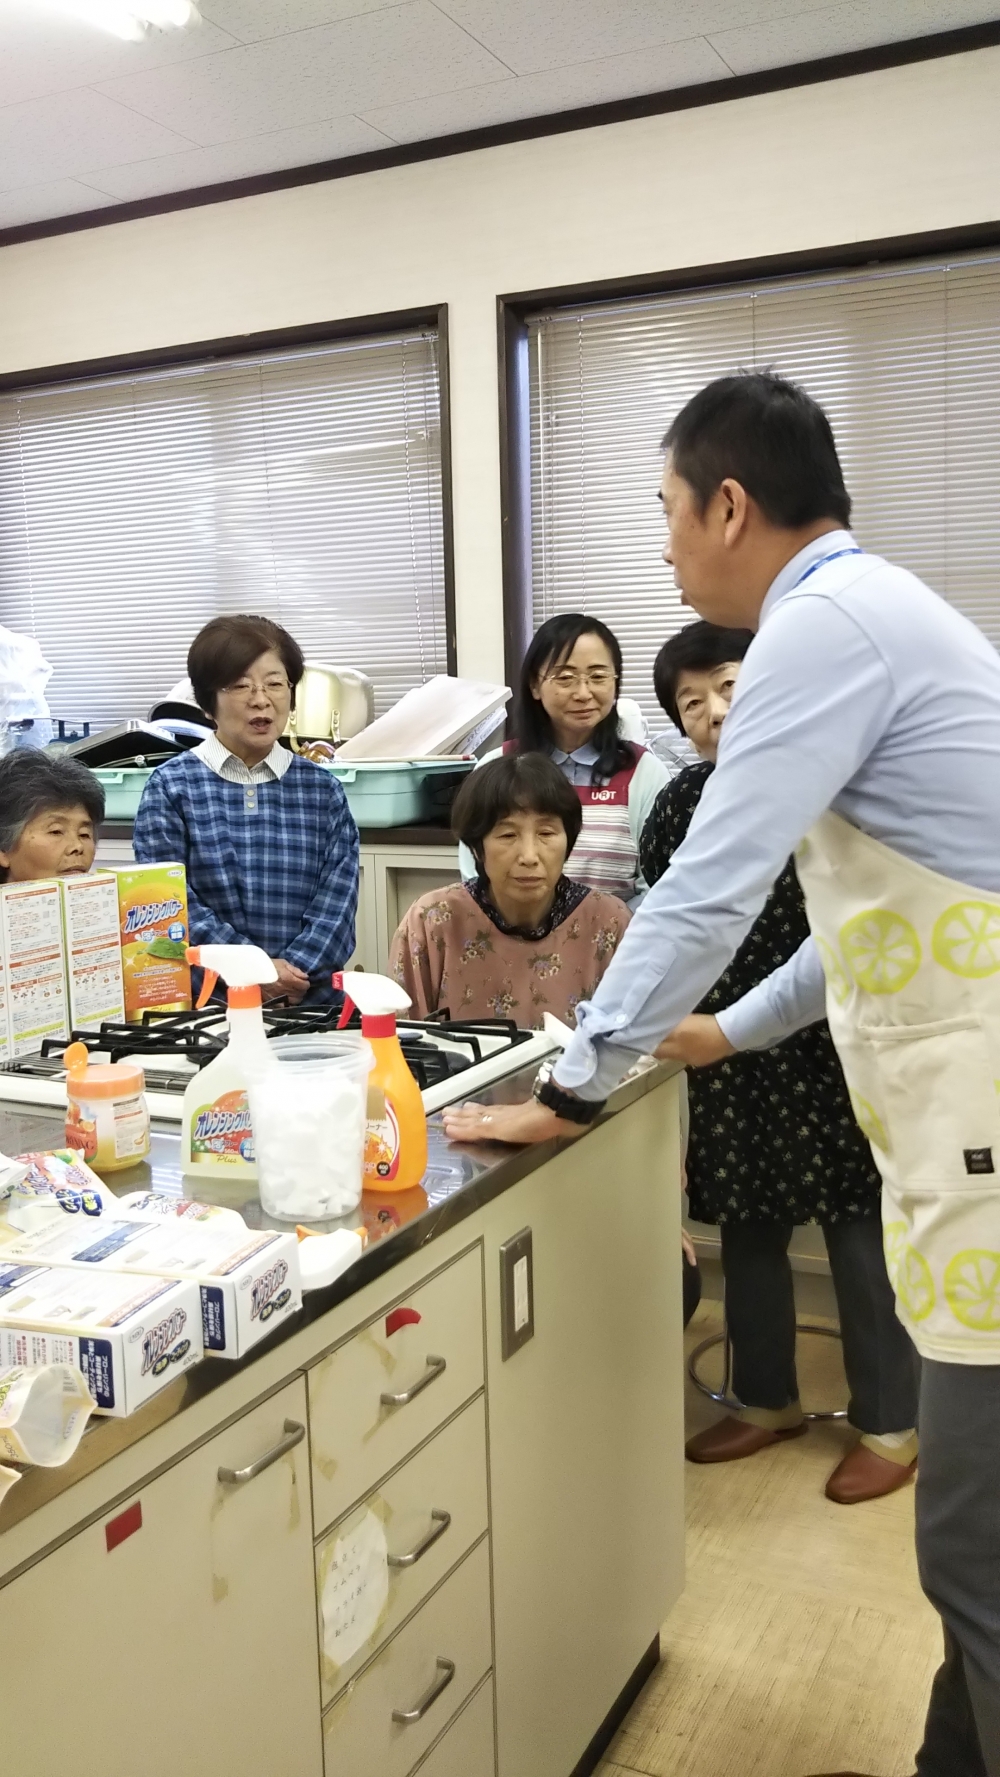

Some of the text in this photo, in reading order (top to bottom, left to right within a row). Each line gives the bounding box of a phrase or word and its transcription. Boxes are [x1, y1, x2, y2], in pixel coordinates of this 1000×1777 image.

[125, 900, 183, 933] オレンジングパワー
[194, 1111, 251, 1139] オレンジングパ
[216, 1154, 237, 1163] Plus
